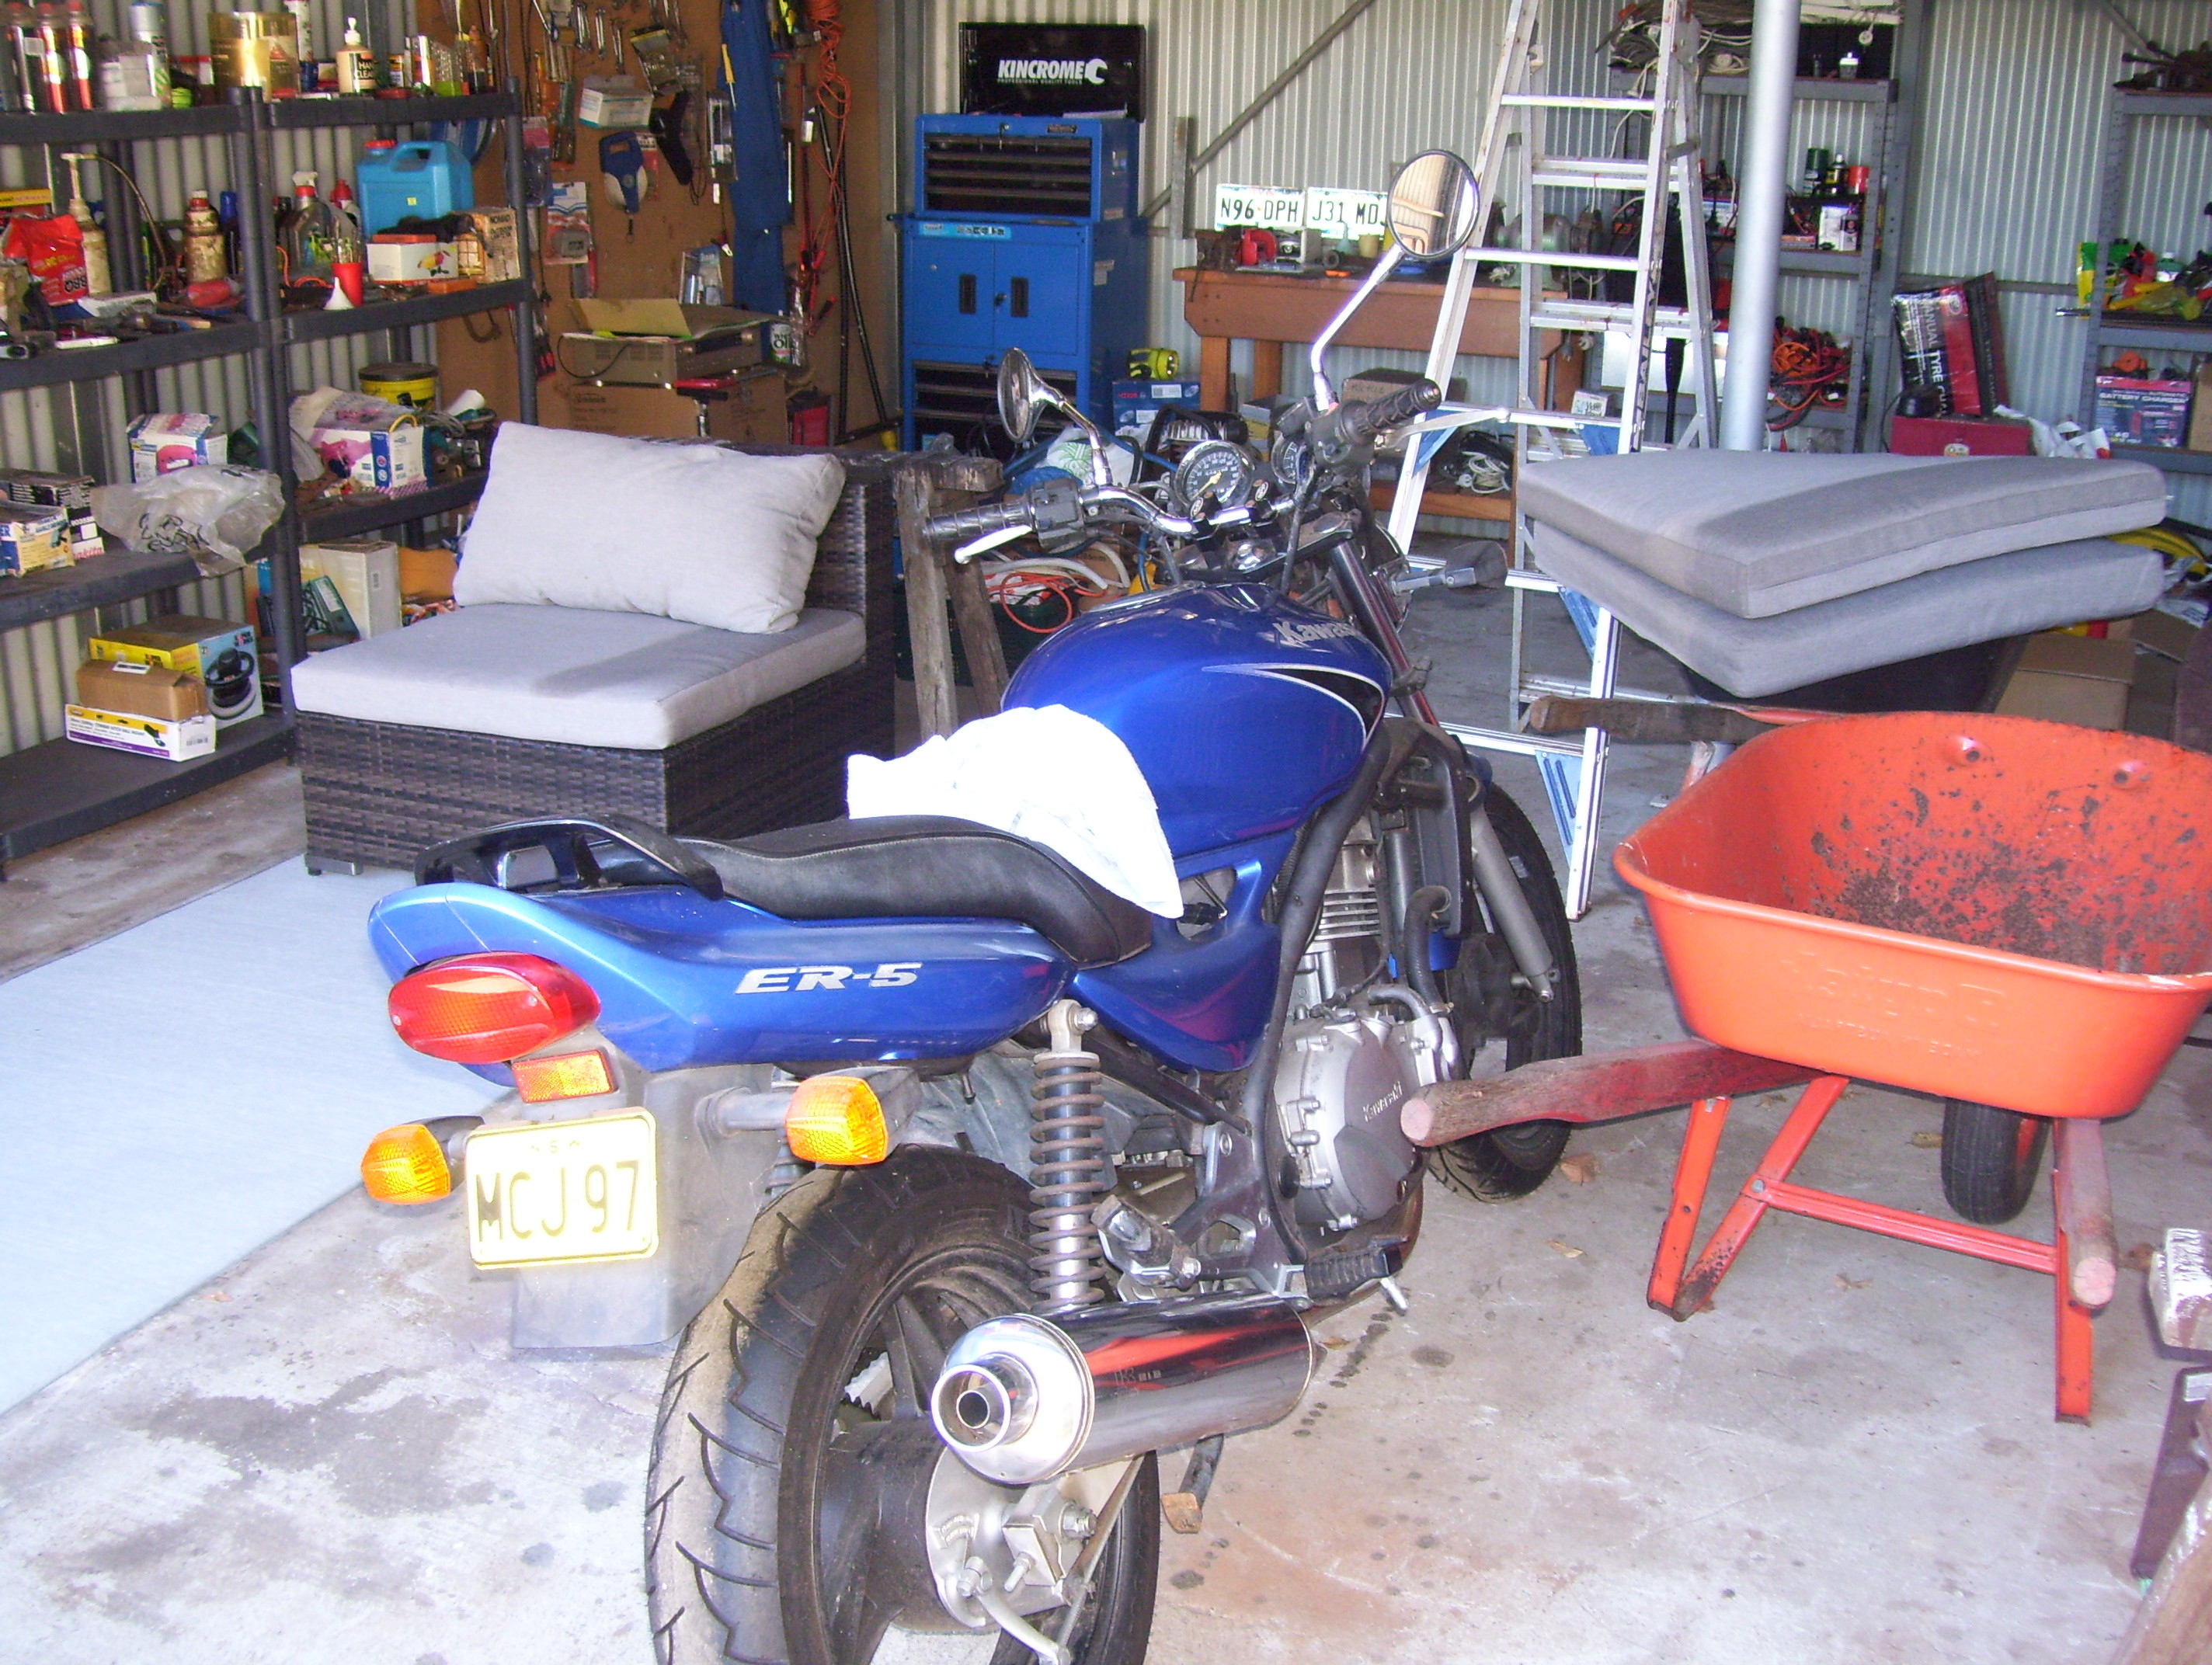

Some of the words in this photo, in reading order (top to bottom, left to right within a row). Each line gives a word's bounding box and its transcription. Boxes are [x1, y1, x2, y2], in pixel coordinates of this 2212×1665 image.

[998, 59, 1085, 79] KINCROME
[1220, 196, 1255, 221] N96
[1264, 200, 1299, 223] DPH
[1312, 200, 1344, 223] J31
[1355, 203, 1385, 227] MD
[1930, 350, 1944, 383] TYRE
[735, 962, 923, 995] ER-5
